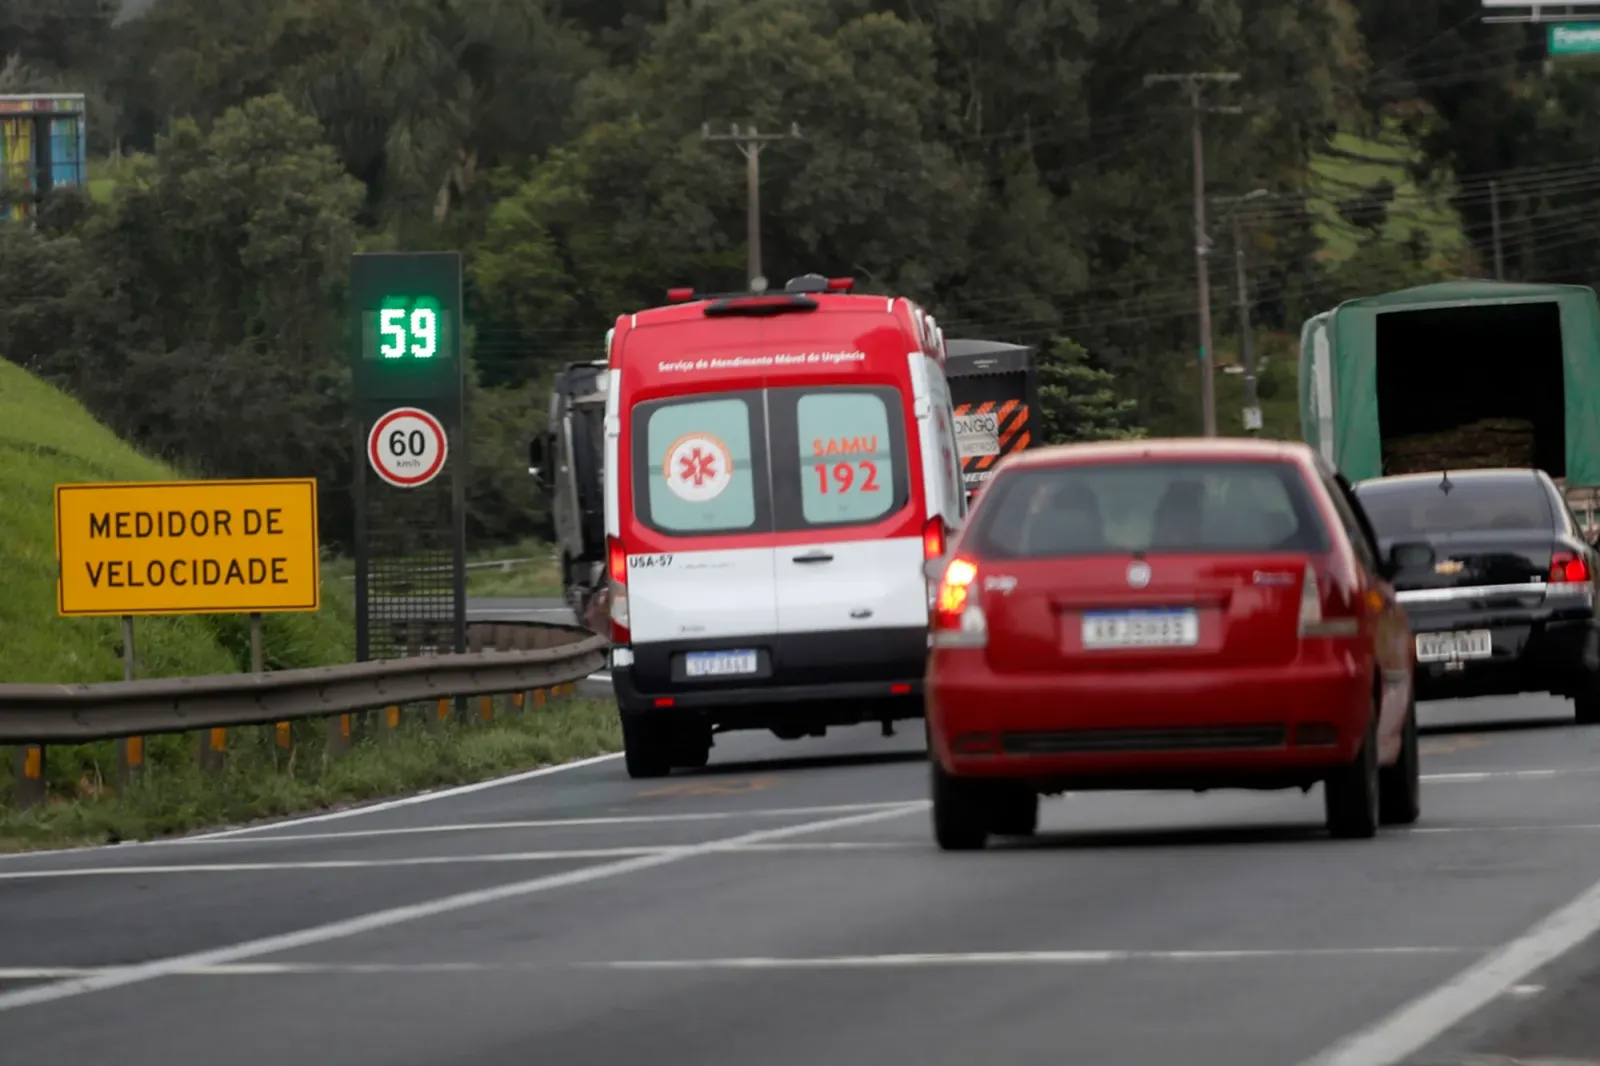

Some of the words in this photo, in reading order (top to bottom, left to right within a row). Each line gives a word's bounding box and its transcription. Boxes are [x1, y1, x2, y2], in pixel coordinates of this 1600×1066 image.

[380, 308, 436, 358] 59
[658, 360, 694, 373] Serviço
[696, 359, 708, 369] de
[710, 355, 773, 368] Atendimento
[822, 350, 865, 364] Urgência
[389, 430, 425, 456] 60
[812, 436, 877, 457] SAMU
[814, 461, 880, 495] 192
[90, 510, 232, 539] MEDIDOR
[244, 508, 284, 535] DE
[85, 557, 289, 588] VELOCIDADE
[629, 555, 673, 569] USA-57
